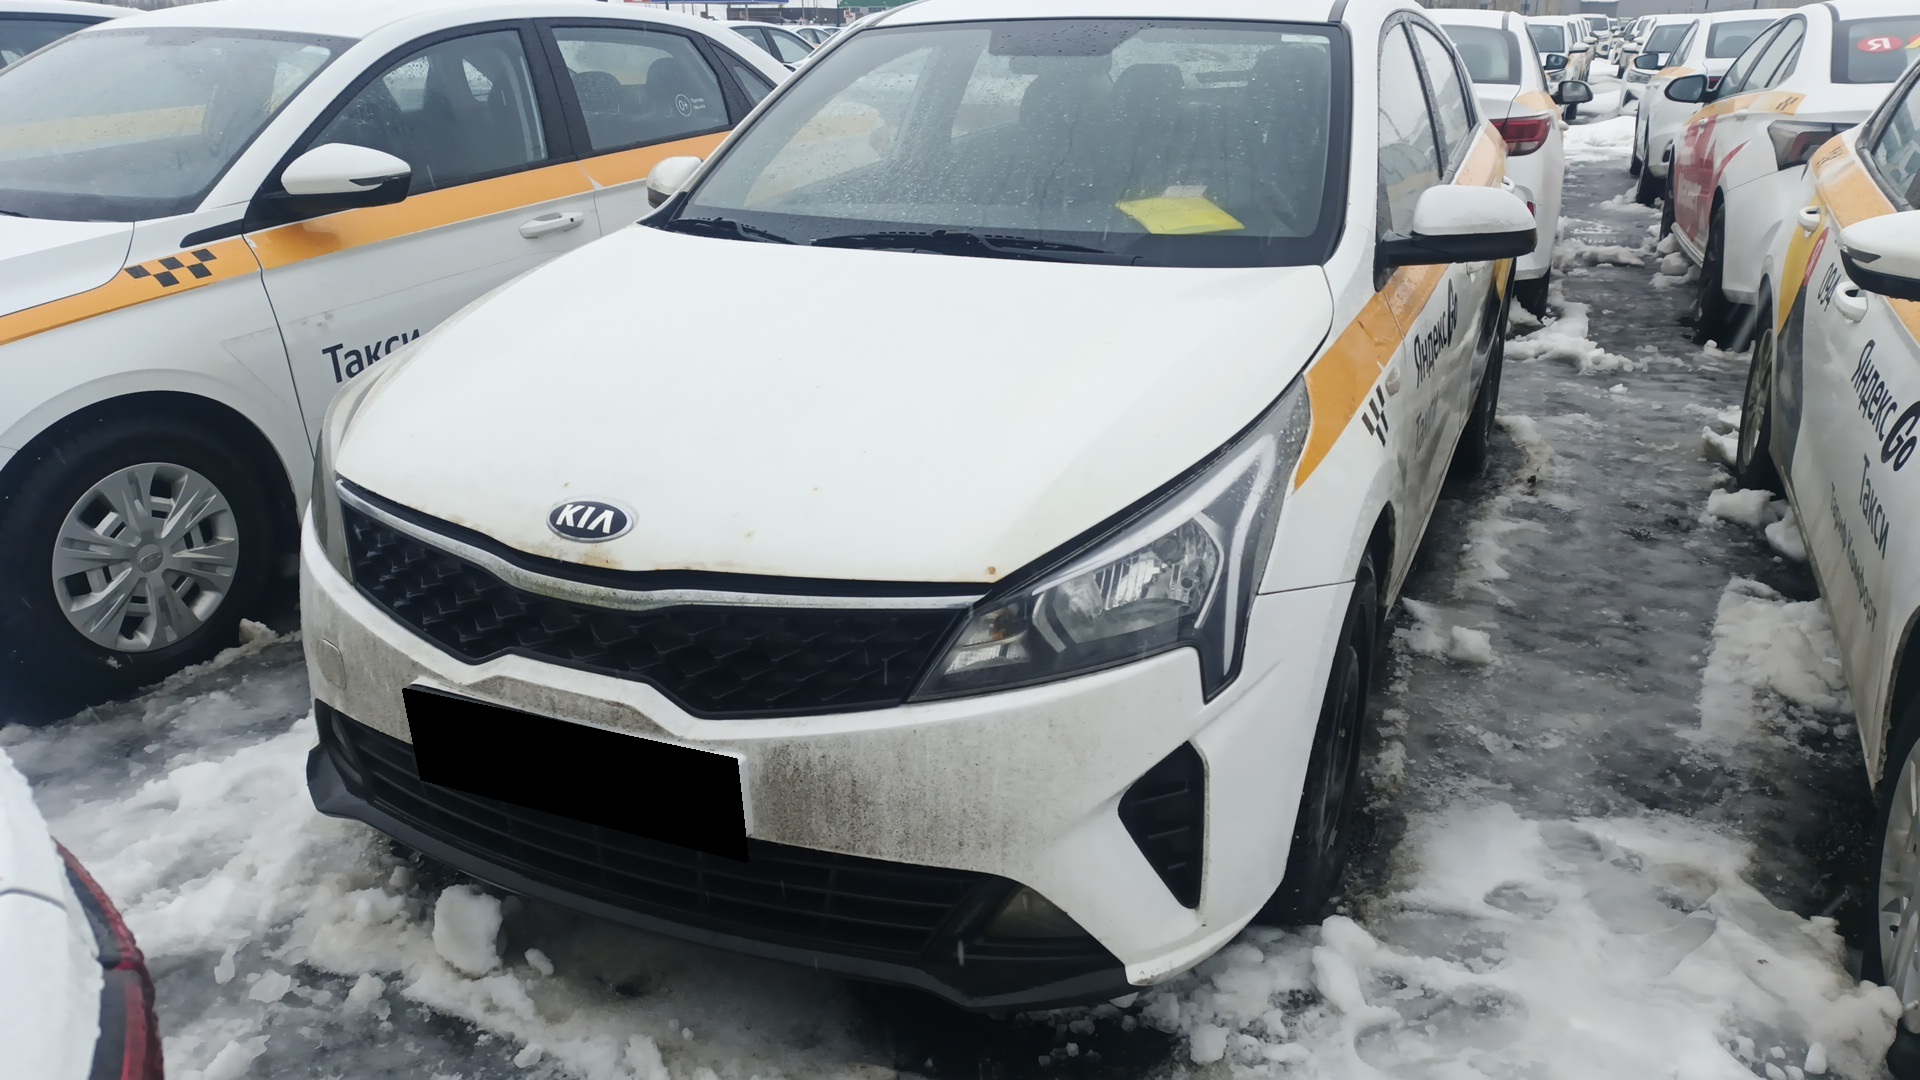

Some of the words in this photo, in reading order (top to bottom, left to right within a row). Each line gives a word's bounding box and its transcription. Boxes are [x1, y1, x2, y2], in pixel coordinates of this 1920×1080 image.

[1867, 37, 1891, 51] Я
[1413, 311, 1447, 389] Яндекс
[1850, 339, 1898, 442] Яндекс
[1880, 400, 1920, 472] Go
[555, 504, 614, 534] KIA
[1859, 452, 1890, 561] Такси
